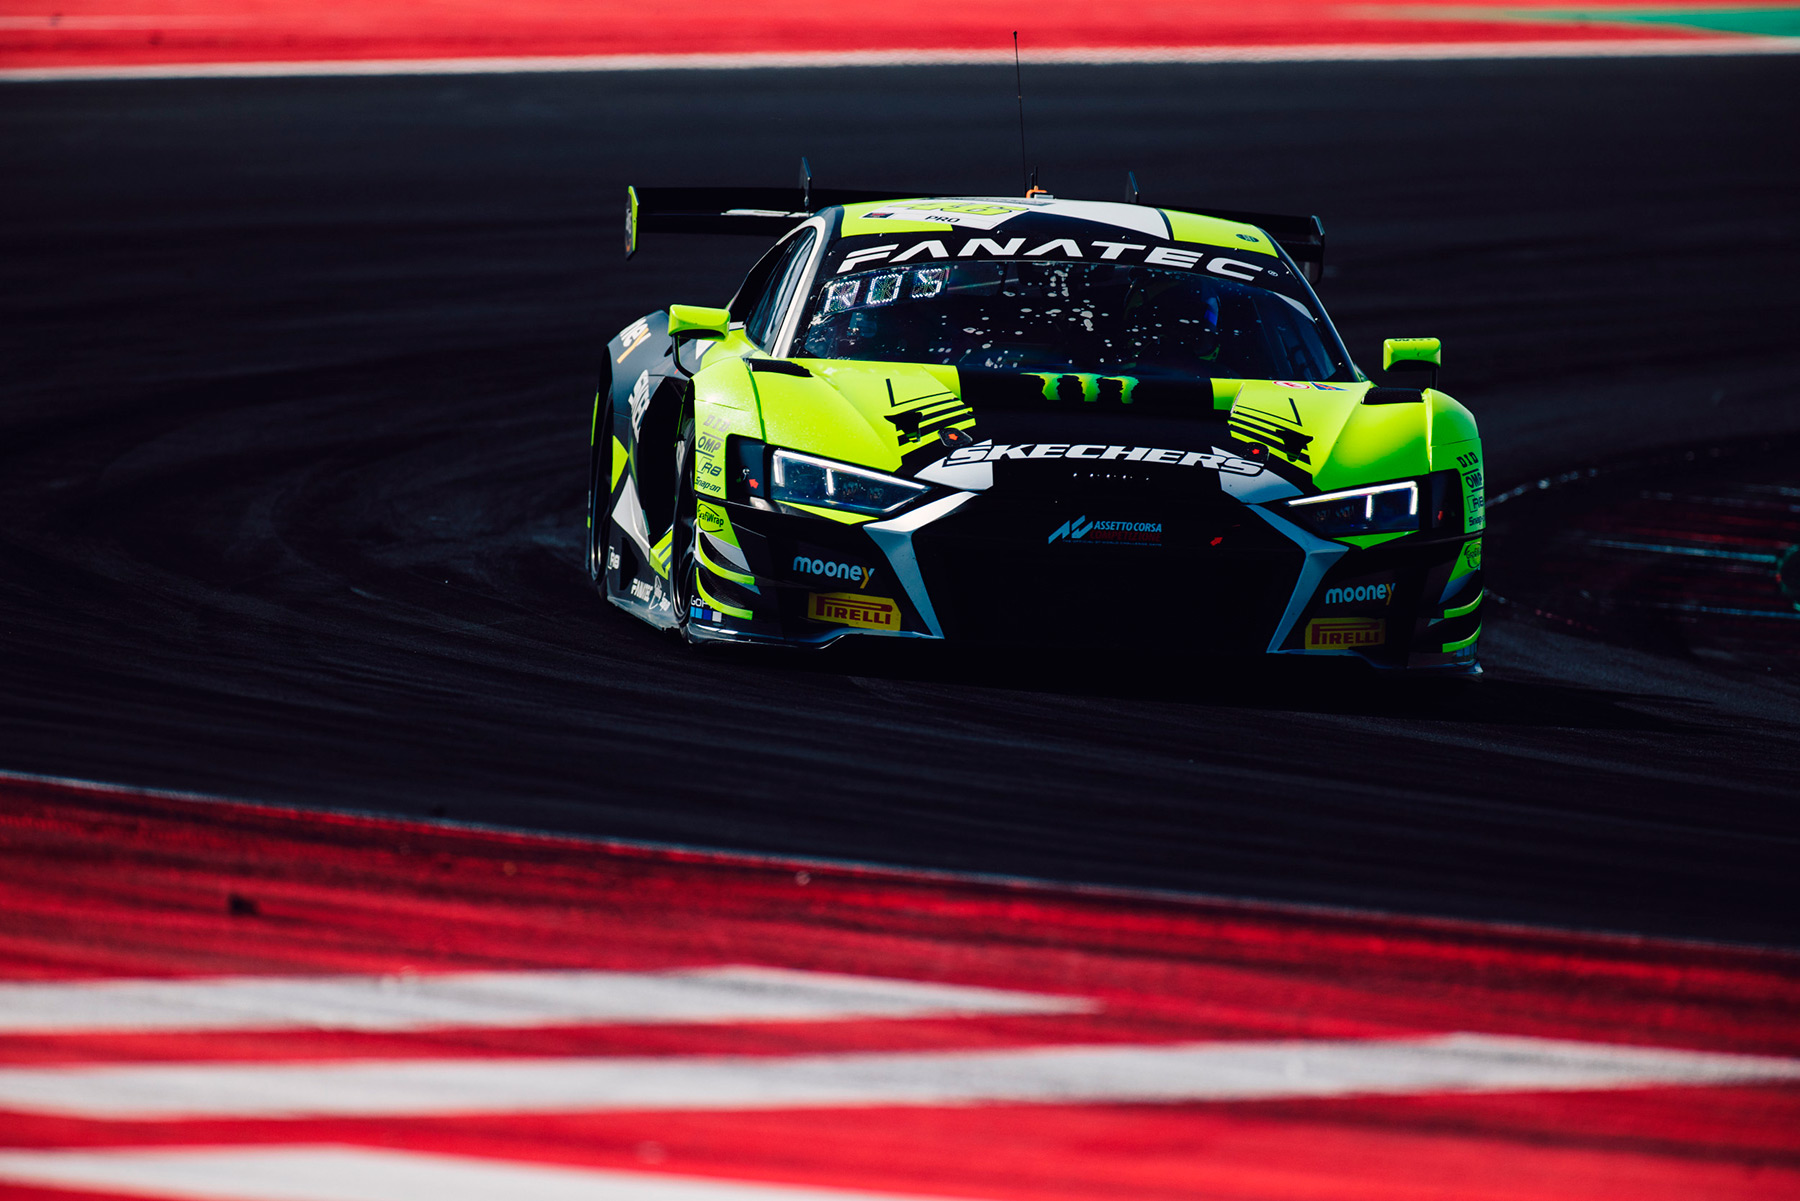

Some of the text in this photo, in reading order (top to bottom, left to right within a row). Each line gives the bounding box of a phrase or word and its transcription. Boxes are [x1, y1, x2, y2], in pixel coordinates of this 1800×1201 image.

[925, 215, 960, 223] PRO
[837, 237, 1264, 282] FANATEC
[823, 267, 944, 315] ROS
[698, 436, 721, 453] OMP
[945, 443, 1265, 476] SKECHERS
[1456, 451, 1479, 468] DID
[1093, 520, 1162, 533] ASSETTO CORSA
[792, 555, 875, 589] mooney
[1325, 582, 1397, 606] mooney
[815, 595, 893, 625] PIRELLI
[1310, 622, 1382, 645] PIRELLI
